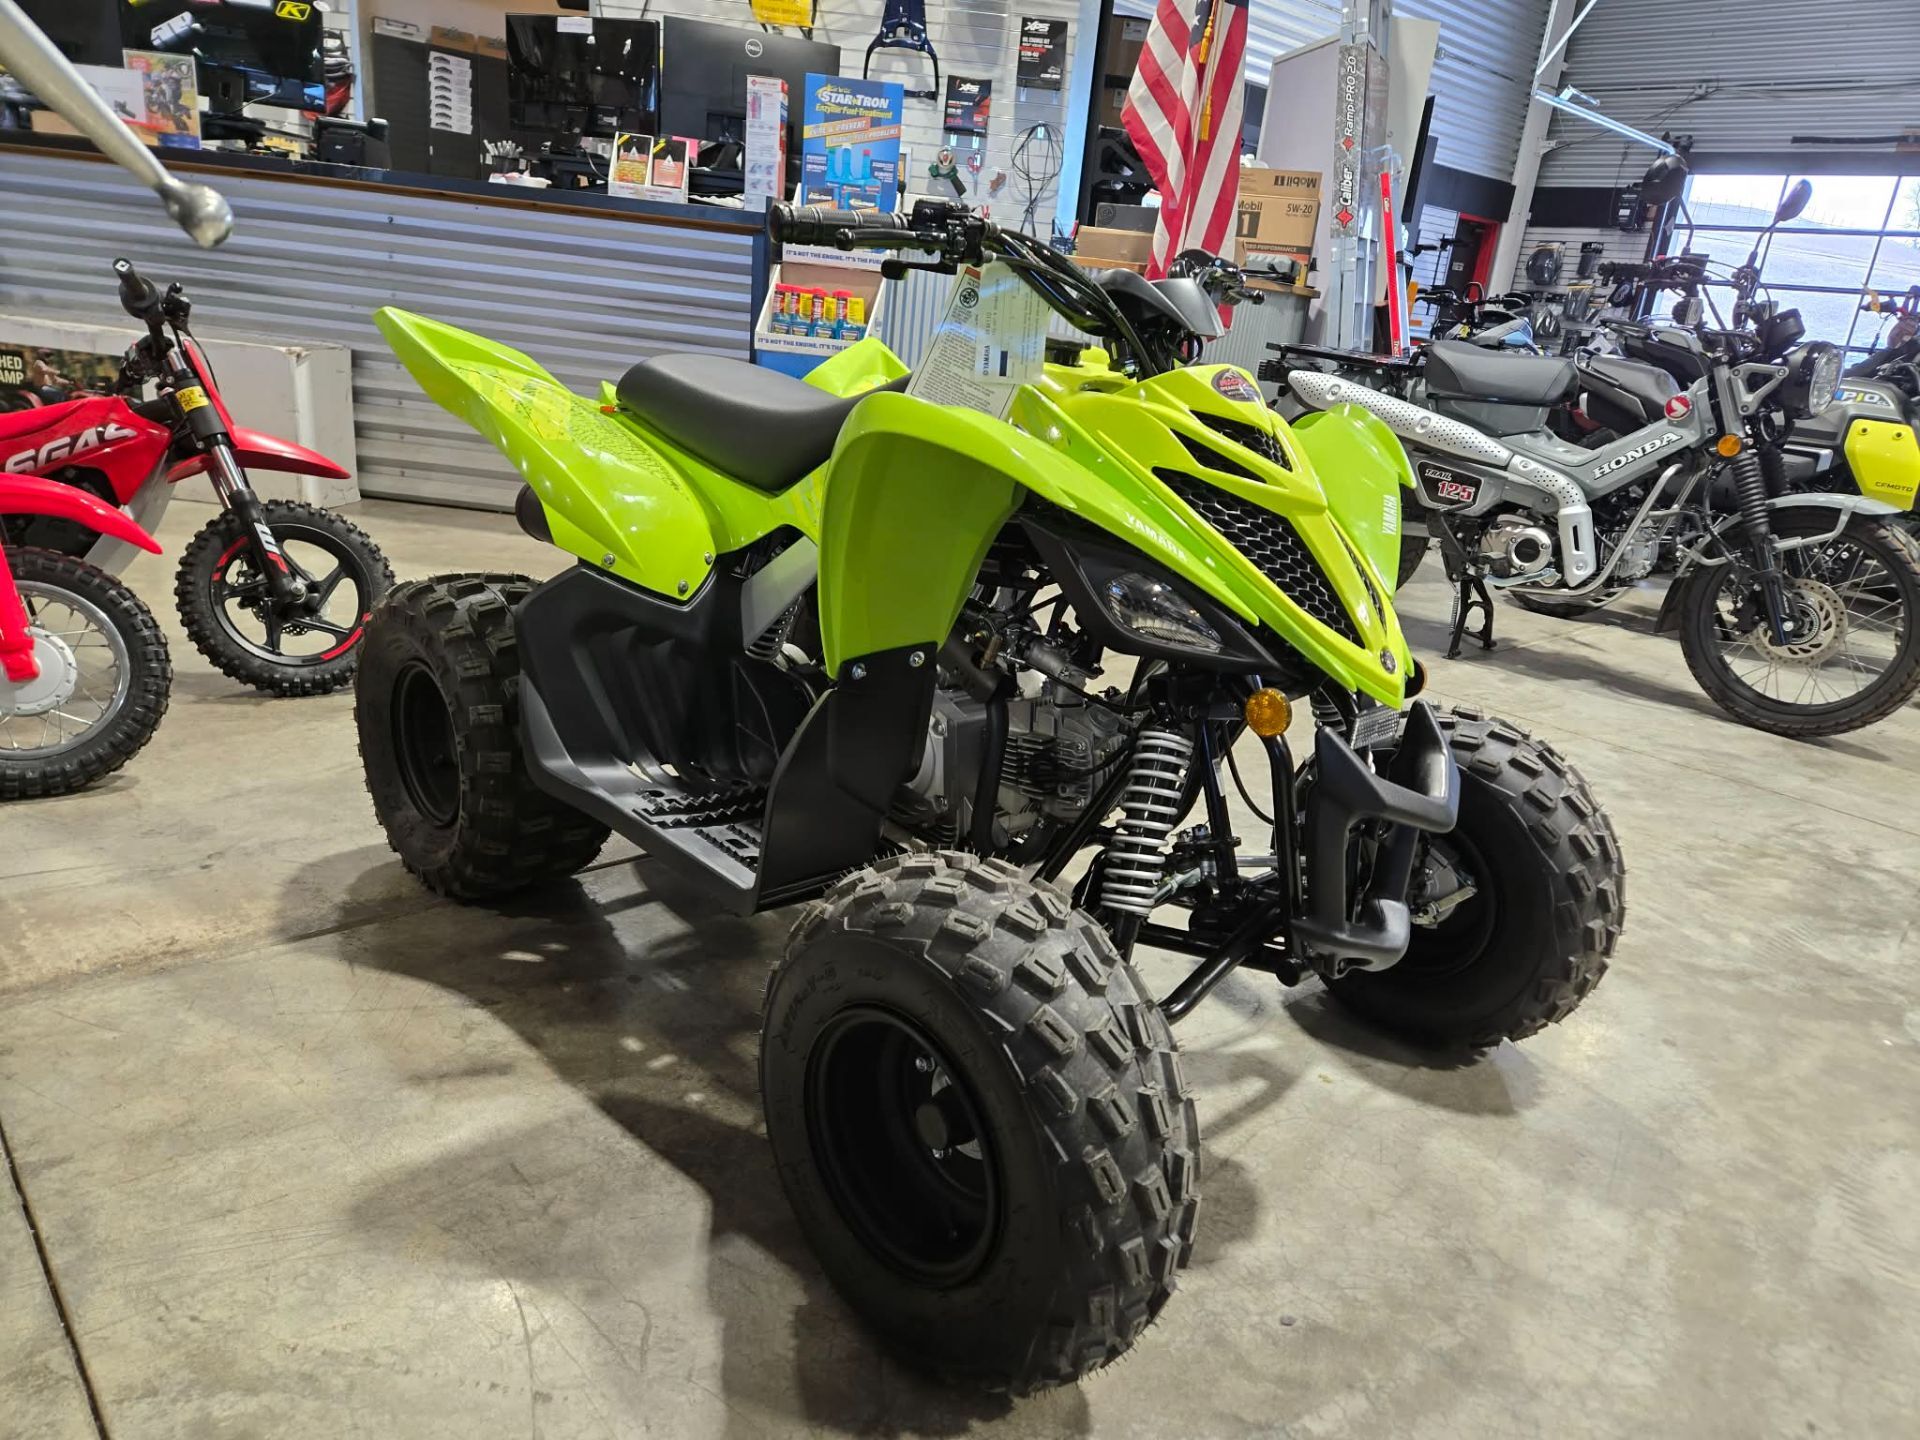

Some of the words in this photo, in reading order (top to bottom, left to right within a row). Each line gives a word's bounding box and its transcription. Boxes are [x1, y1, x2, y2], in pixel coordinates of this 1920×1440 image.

[1024, 21, 1050, 31] XPS
[1347, 56, 1357, 74] 2.0
[958, 83, 980, 92] XPS
[1346, 75, 1356, 102] PRO
[1344, 104, 1356, 137] Ramp
[1286, 176, 1318, 189] Mobil
[1339, 165, 1353, 206] Caliber
[1287, 203, 1313, 214] 5W-20
[1592, 432, 1683, 480] HONDA
[1425, 468, 1452, 481] TRAIL
[1438, 481, 1475, 502] 125
[1875, 481, 1914, 492] CFMOTO
[1382, 494, 1397, 535] YAMAHA
[1124, 511, 1186, 562] YAMAHA
